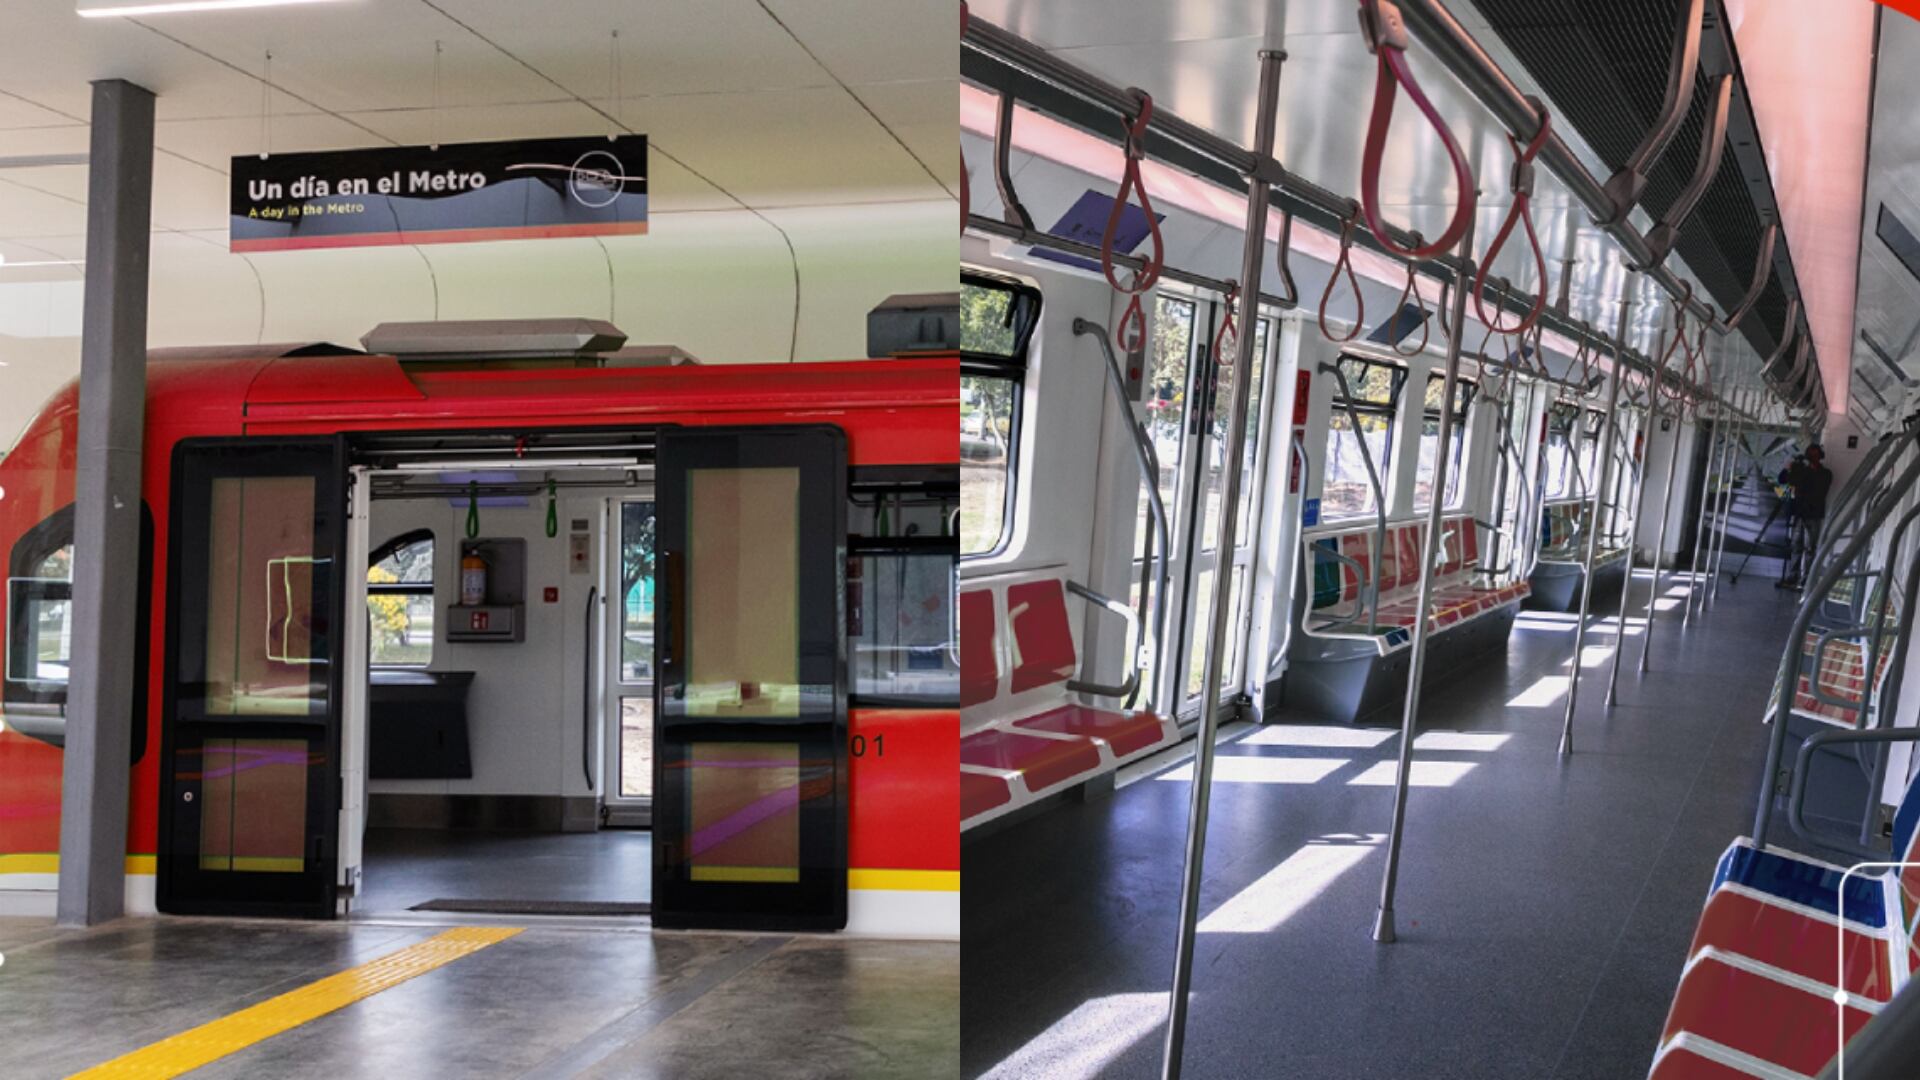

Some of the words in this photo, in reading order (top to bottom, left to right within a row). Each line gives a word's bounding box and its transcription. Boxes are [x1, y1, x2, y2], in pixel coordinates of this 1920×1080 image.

[248, 179, 283, 201] Un
[289, 176, 330, 199] día
[337, 178, 369, 196] en
[377, 171, 400, 194] el
[408, 169, 487, 193] Metro
[249, 207, 258, 218] A
[261, 205, 284, 219] day
[287, 204, 299, 216] in
[303, 203, 323, 216] the
[327, 203, 365, 214] Metro
